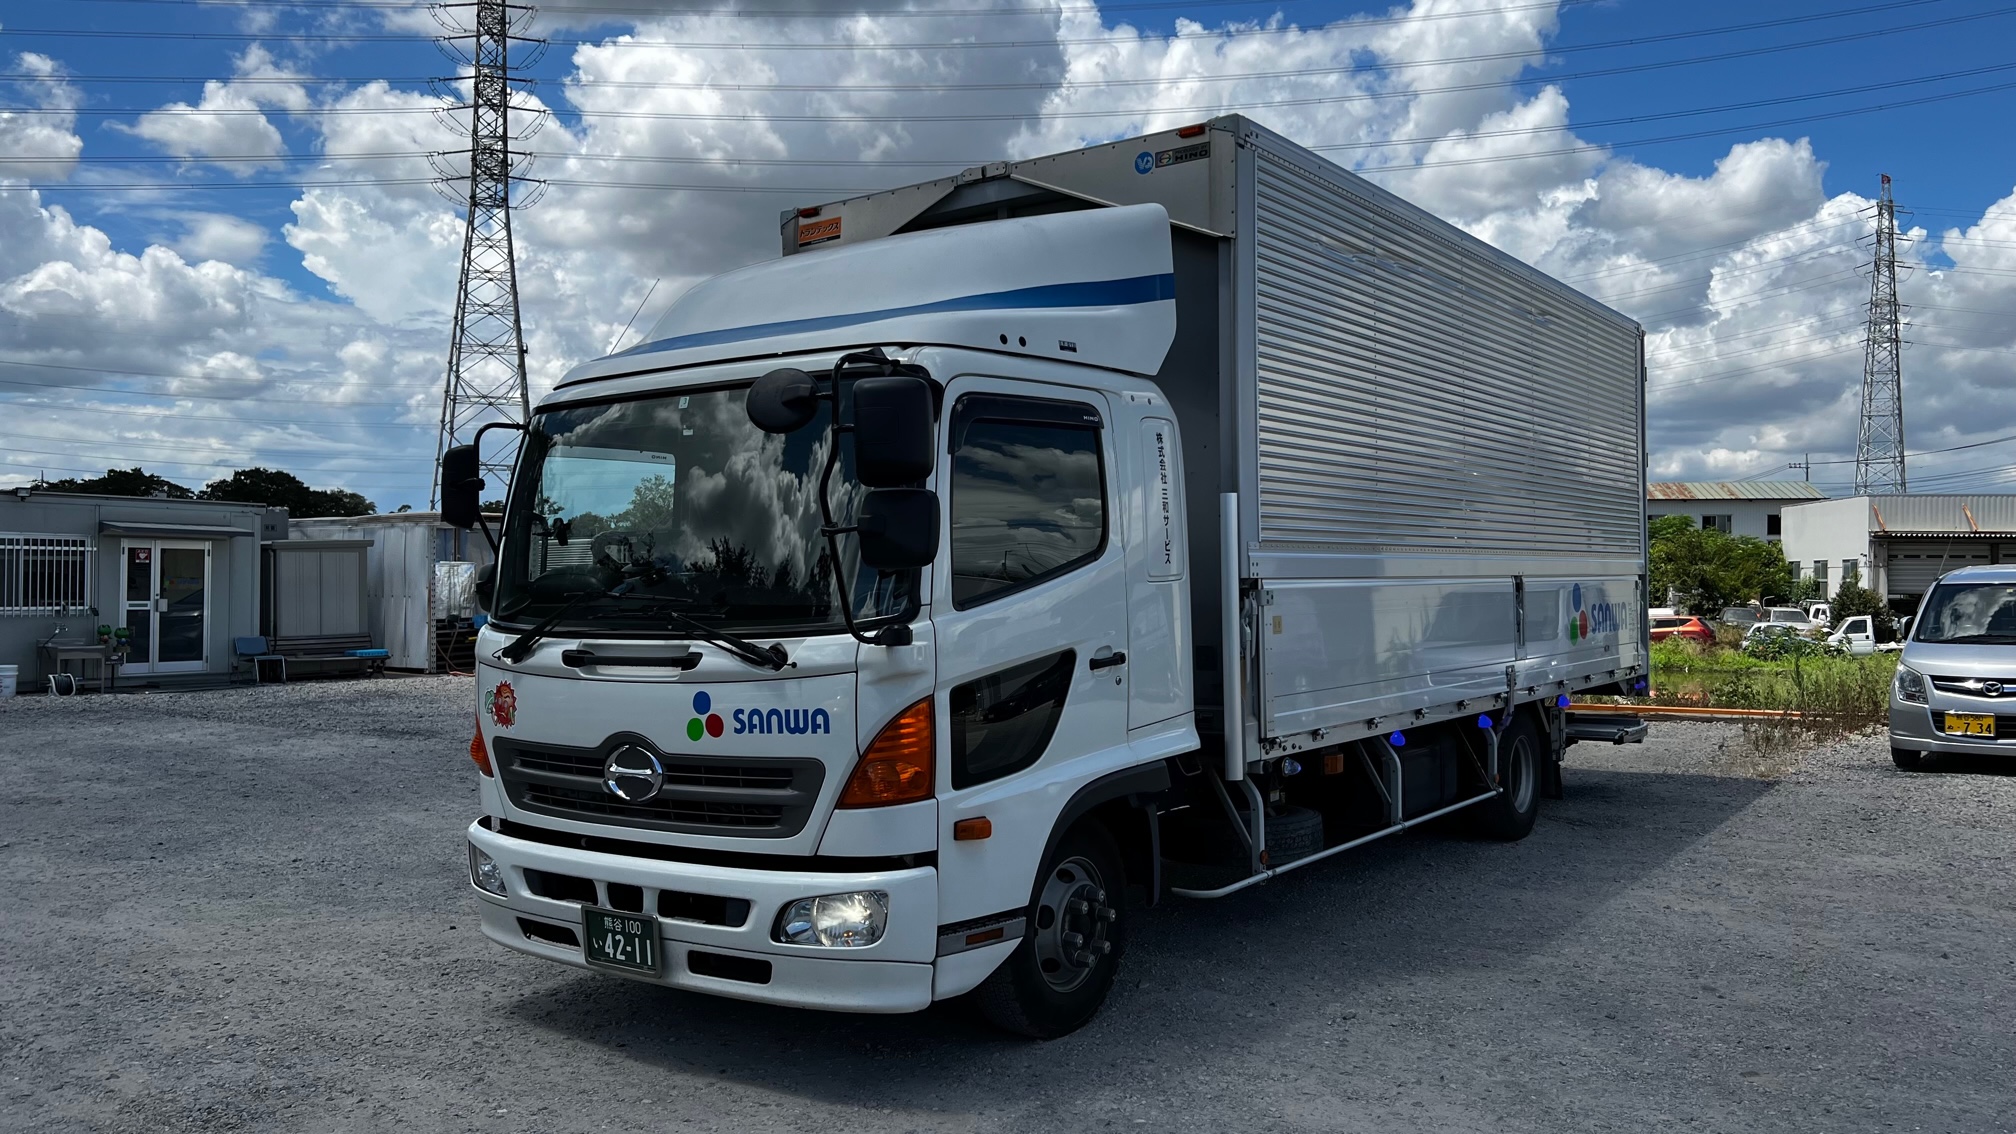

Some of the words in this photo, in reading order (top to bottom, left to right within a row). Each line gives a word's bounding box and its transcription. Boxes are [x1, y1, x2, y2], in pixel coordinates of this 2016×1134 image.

[1175, 149, 1208, 161] HINO
[800, 222, 840, 238] トランテックス
[1591, 601, 1628, 634] SANWA
[733, 708, 830, 735] SANWA
[604, 916, 622, 931] 熊谷
[625, 919, 642, 935] 100
[592, 937, 603, 949] い
[604, 932, 652, 966] 42-11
